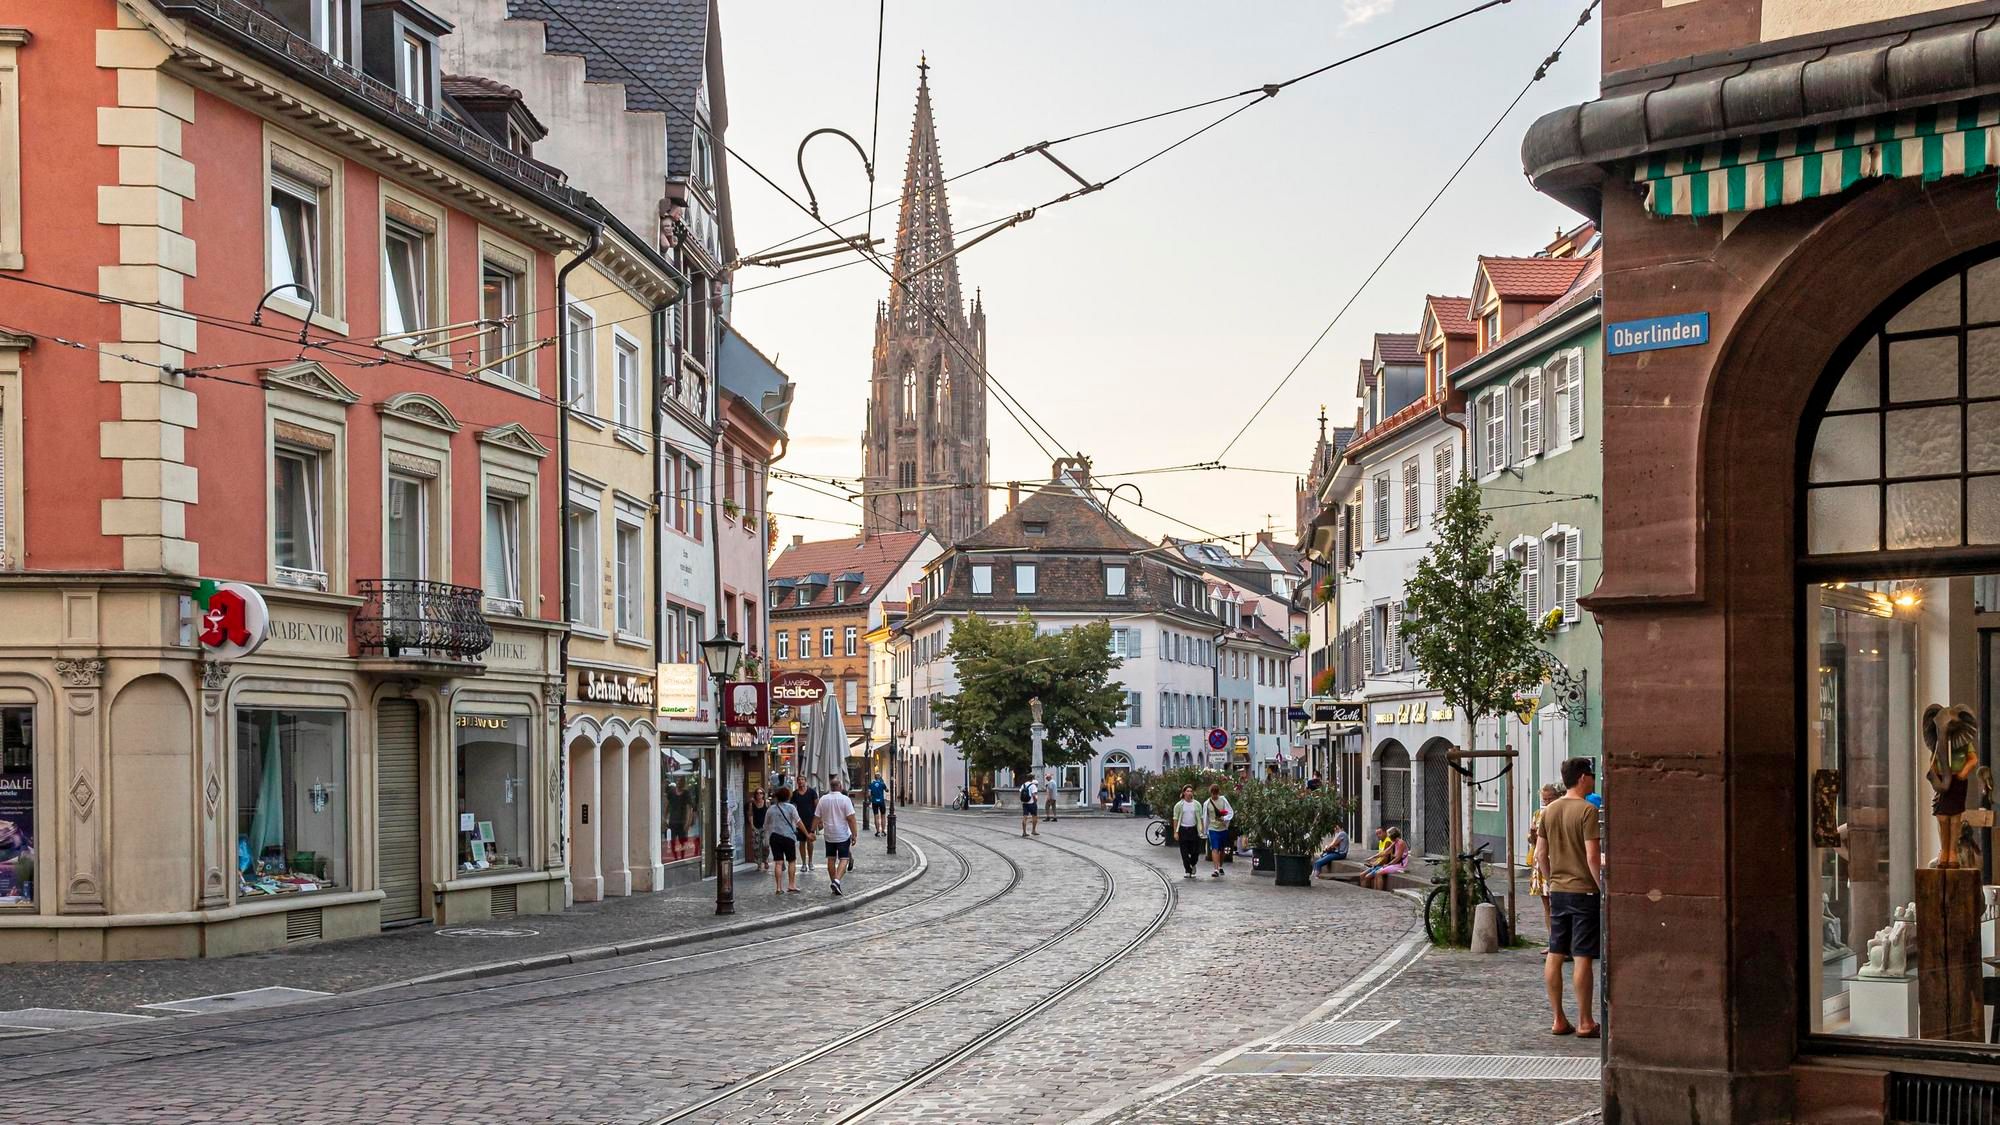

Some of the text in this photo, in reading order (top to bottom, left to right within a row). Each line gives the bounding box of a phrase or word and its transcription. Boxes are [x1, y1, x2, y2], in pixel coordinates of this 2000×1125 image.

[1614, 321, 1700, 347] Oberlinden
[587, 670, 653, 704] Schuh-Trost
[773, 686, 823, 699] Steiber
[1333, 708, 1360, 720] Rath
